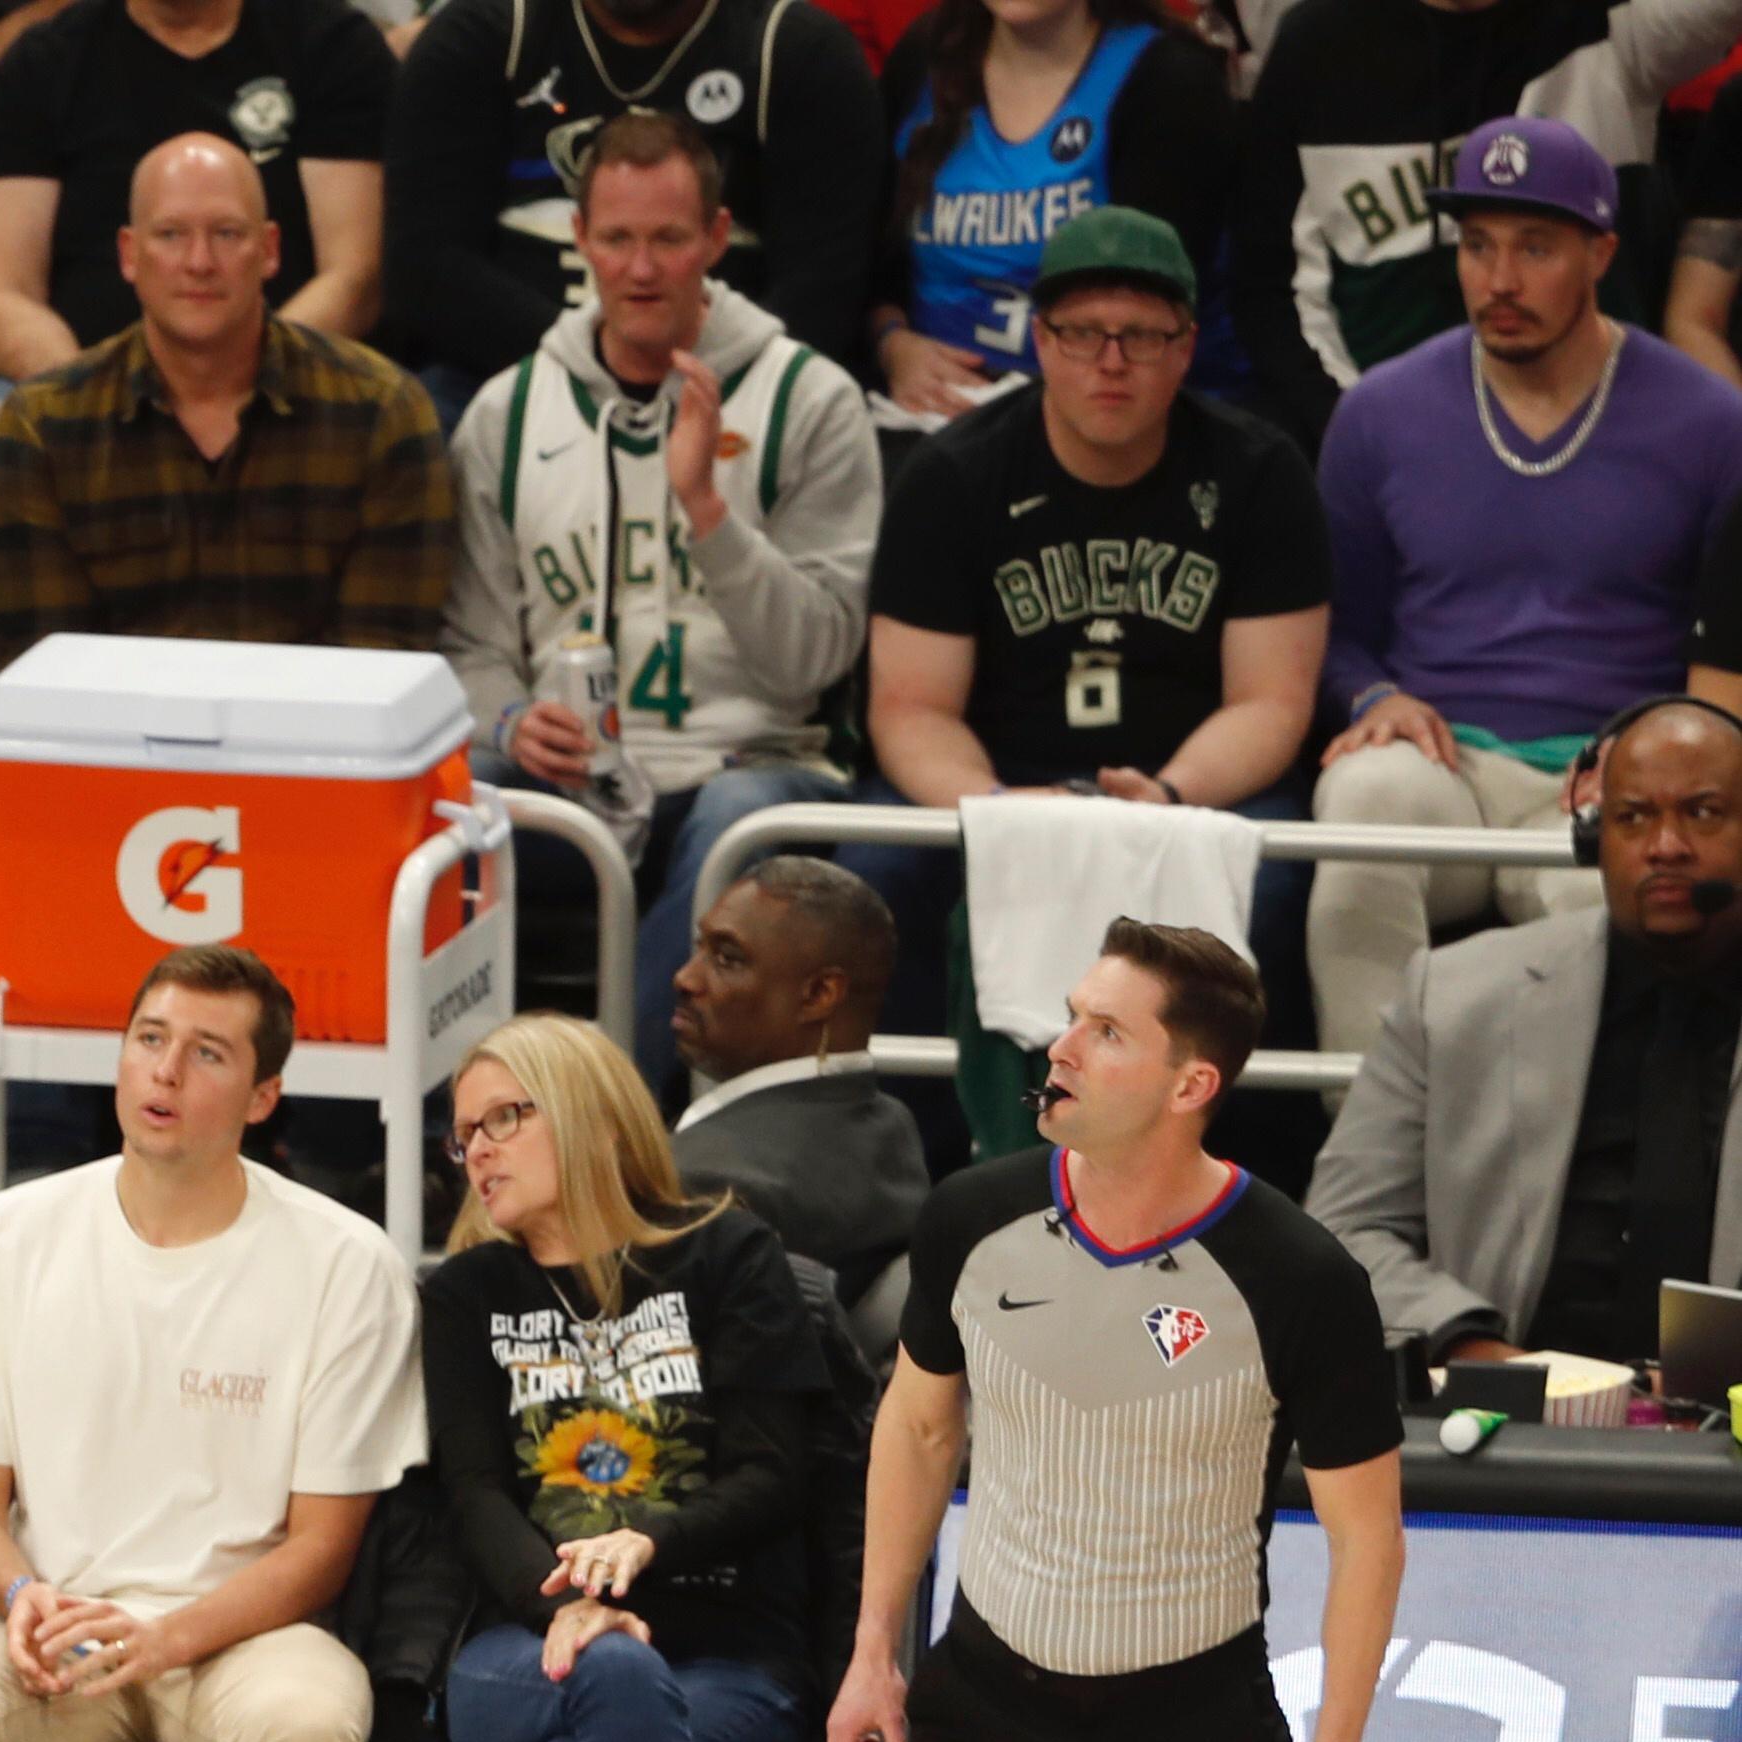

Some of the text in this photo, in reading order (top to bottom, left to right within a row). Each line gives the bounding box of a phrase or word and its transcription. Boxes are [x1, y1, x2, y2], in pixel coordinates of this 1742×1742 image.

[994, 537, 1220, 637] BUCKS
[117, 806, 243, 946] G
[490, 1309, 565, 1340] GLORY
[631, 1352, 703, 1400] GOD!
